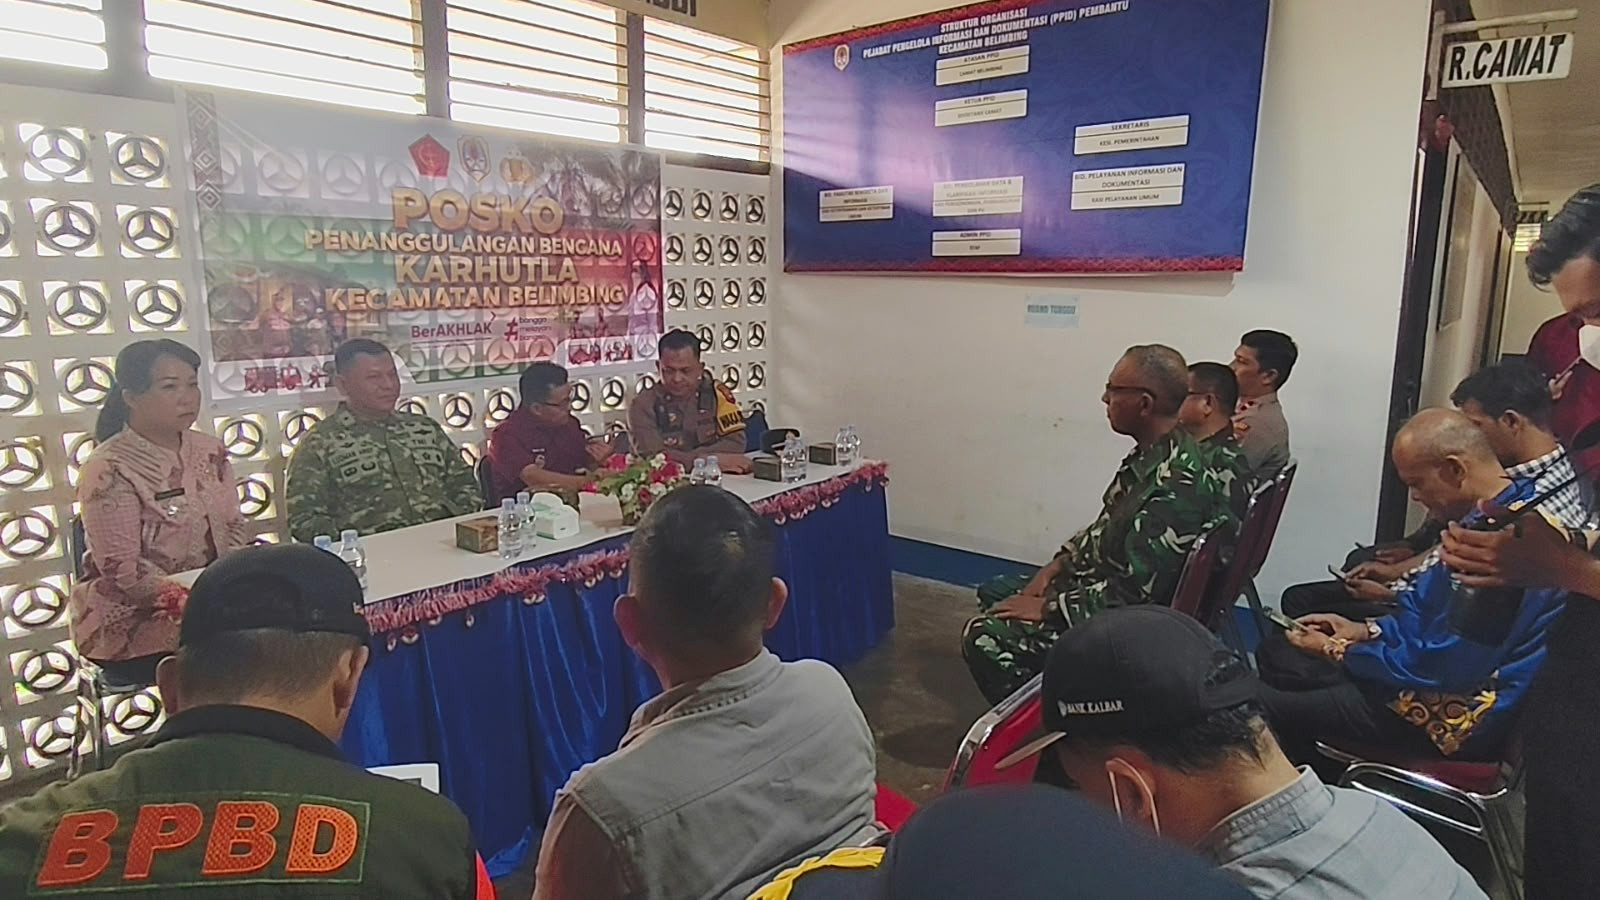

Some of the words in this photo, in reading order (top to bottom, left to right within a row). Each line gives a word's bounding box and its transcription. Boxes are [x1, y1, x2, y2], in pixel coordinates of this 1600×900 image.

[863, 45, 891, 58] PEJABAT
[892, 37, 930, 52] PENGELOLA
[931, 30, 973, 45] INFORMASI
[973, 27, 990, 39] DAN
[991, 17, 1048, 36] DOKUMENTASI
[1049, 10, 1077, 26] (PPID)
[1078, 1, 1130, 19] PEMBANTU
[940, 17, 979, 33] STRUKTUR
[980, 8, 1028, 26] ORGANISASI
[938, 38, 982, 55] KECAMATAN
[984, 30, 1028, 47] BELIMBING
[1448, 34, 1567, 81] R.CAMAT
[1111, 121, 1150, 131] SEKRETARIS
[1114, 136, 1160, 145] PEMERINTAHAN
[1088, 171, 1126, 179] PELAYANAN
[1127, 168, 1166, 176] INFORMASI
[1102, 179, 1150, 188] DOKUMENTASI
[391, 186, 564, 235] POSKO
[304, 229, 535, 254] PENANGGULANGAN
[539, 236, 623, 256] BENCANA
[394, 254, 579, 284] KARHUTLA
[325, 285, 500, 311] KECAMATAN
[508, 284, 625, 307] BELIMBING
[411, 322, 492, 338] BerAKHLAK
[1087, 700, 1124, 714] KALBAR
[36, 800, 359, 887] BPBD
